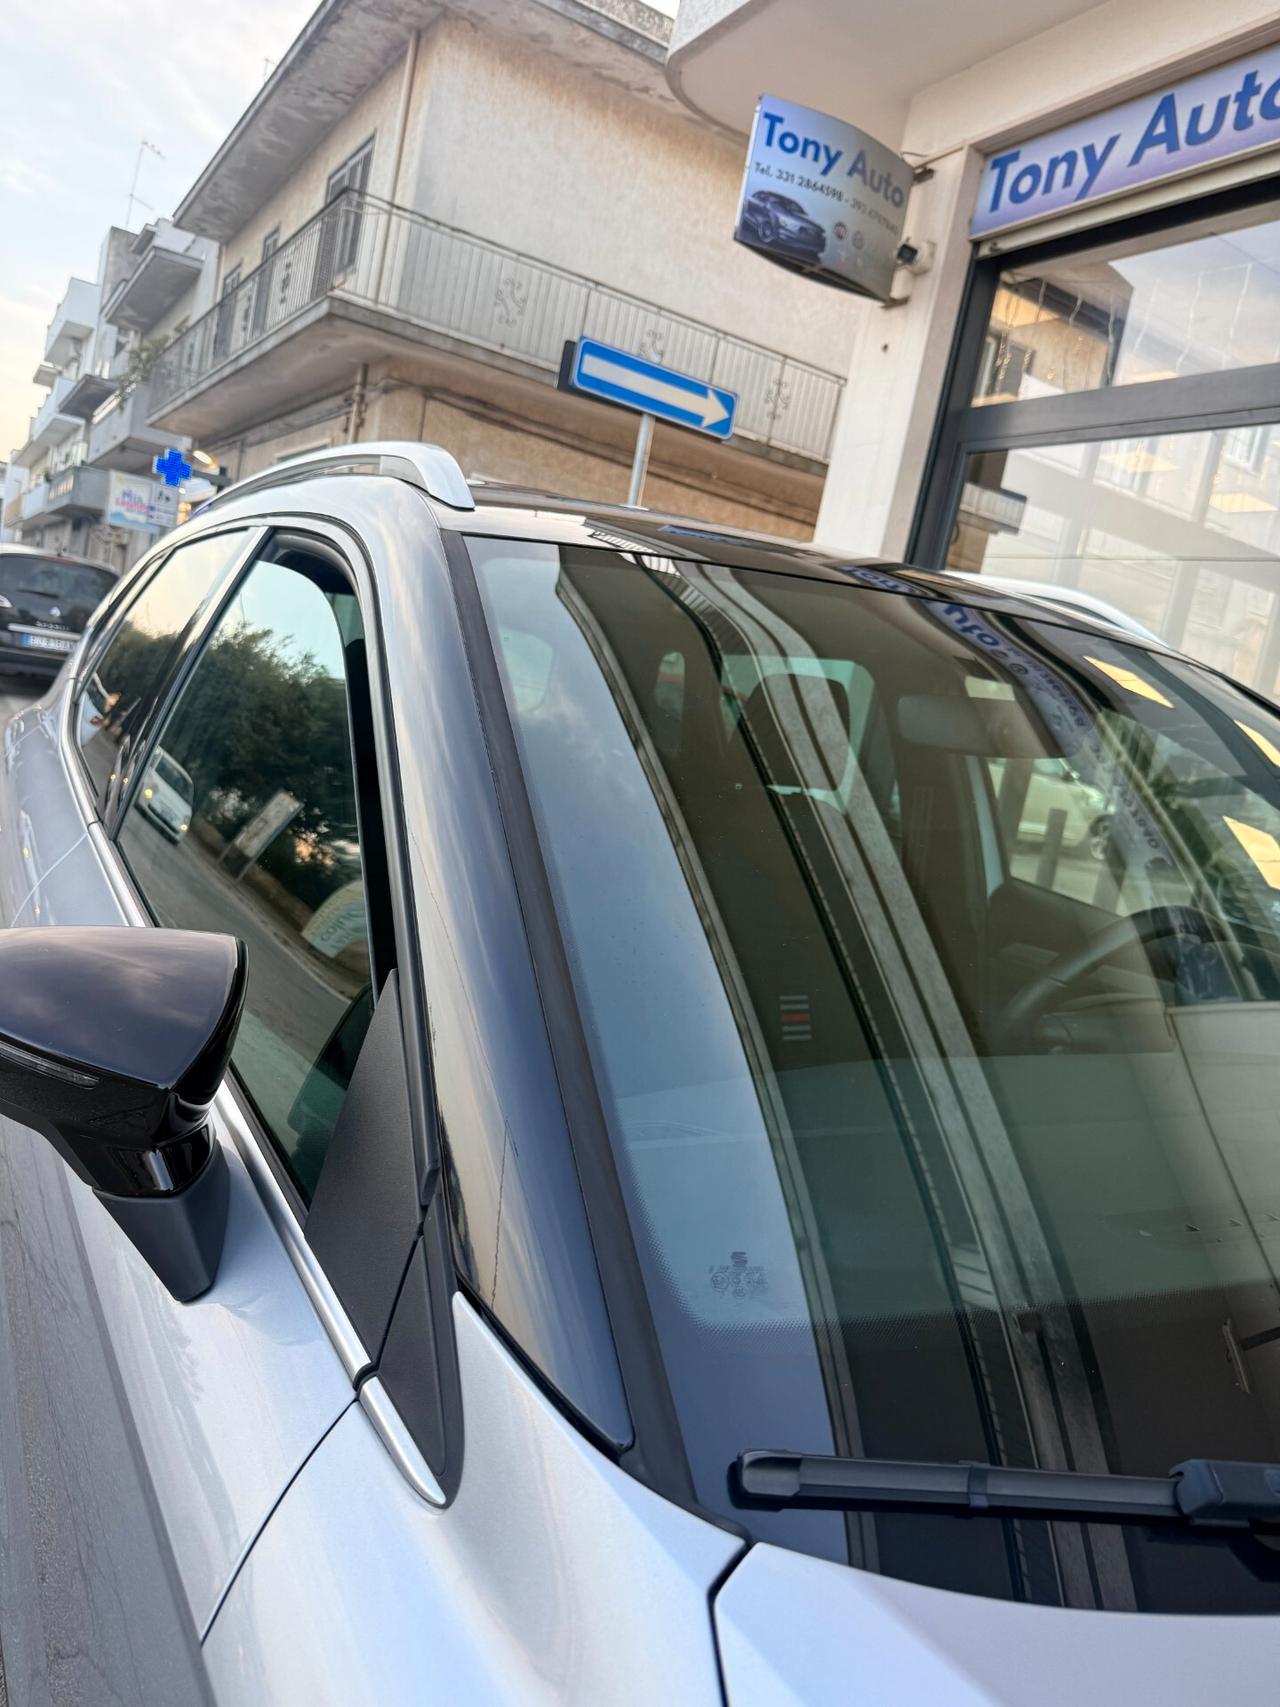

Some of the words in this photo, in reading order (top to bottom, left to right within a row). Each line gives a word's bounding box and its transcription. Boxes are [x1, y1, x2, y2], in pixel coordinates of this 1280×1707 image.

[755, 163, 773, 177] Tel.
[763, 112, 844, 176] Tony
[847, 149, 905, 208] Auto
[989, 133, 1122, 213] Tony
